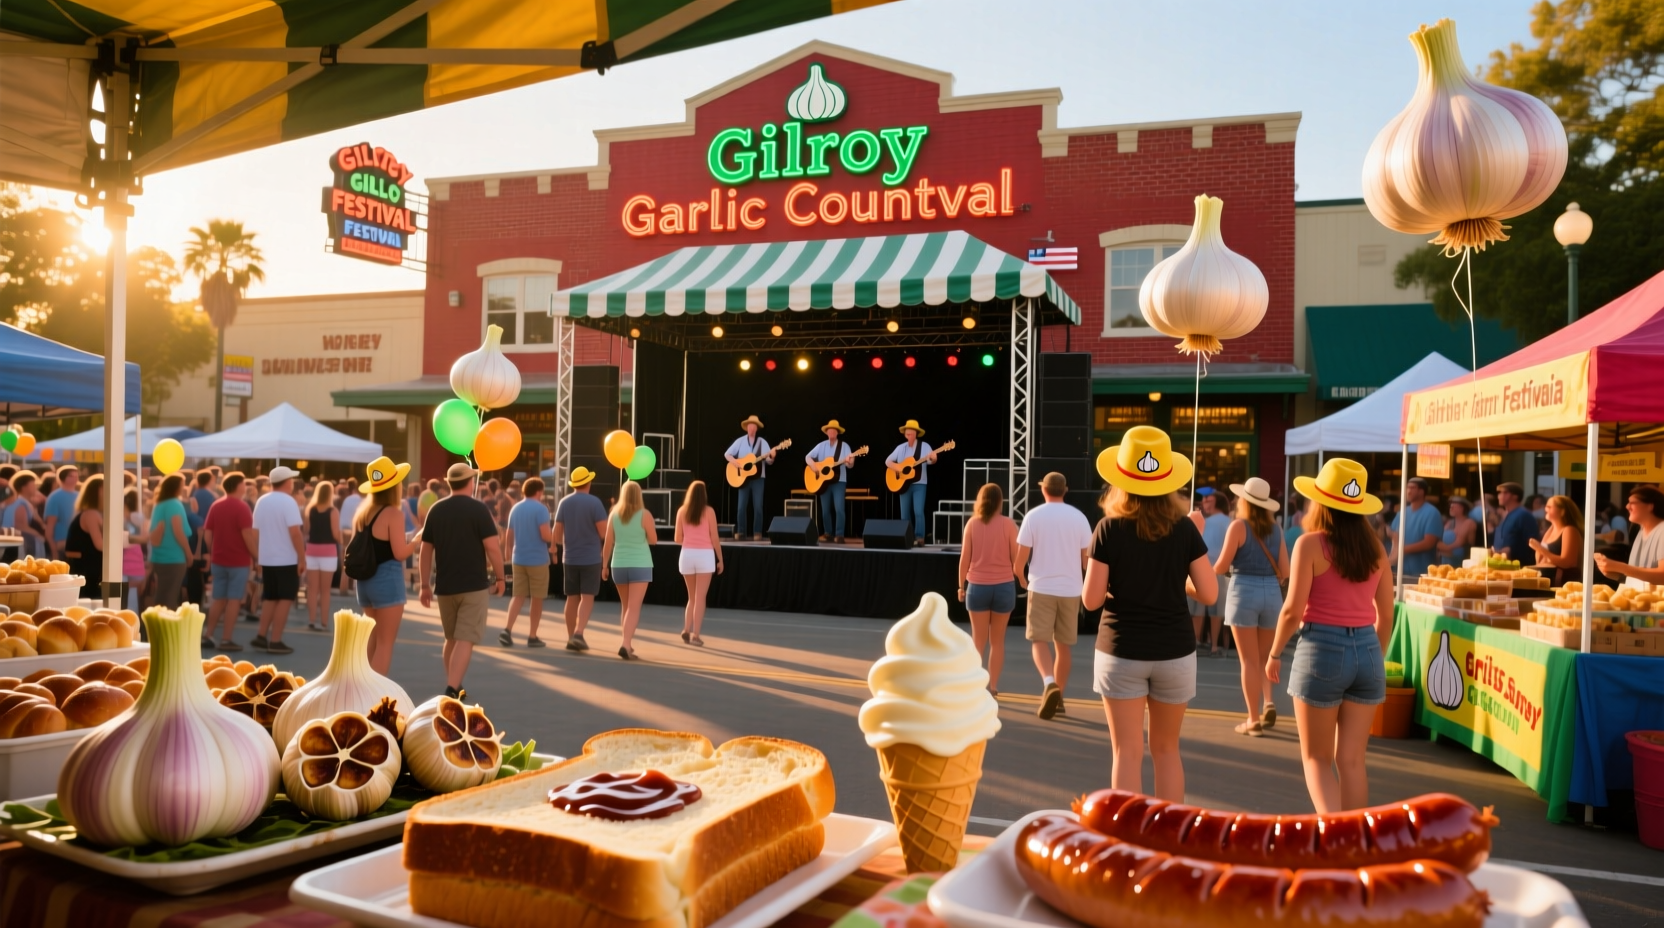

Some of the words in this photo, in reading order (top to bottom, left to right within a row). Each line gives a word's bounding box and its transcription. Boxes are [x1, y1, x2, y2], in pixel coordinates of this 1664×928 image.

[707, 122, 928, 185] Gilroy
[332, 188, 417, 234] FESTIVAL
[350, 172, 401, 203] GILLO
[622, 189, 768, 237] Garlic
[784, 168, 1014, 227] Countval
